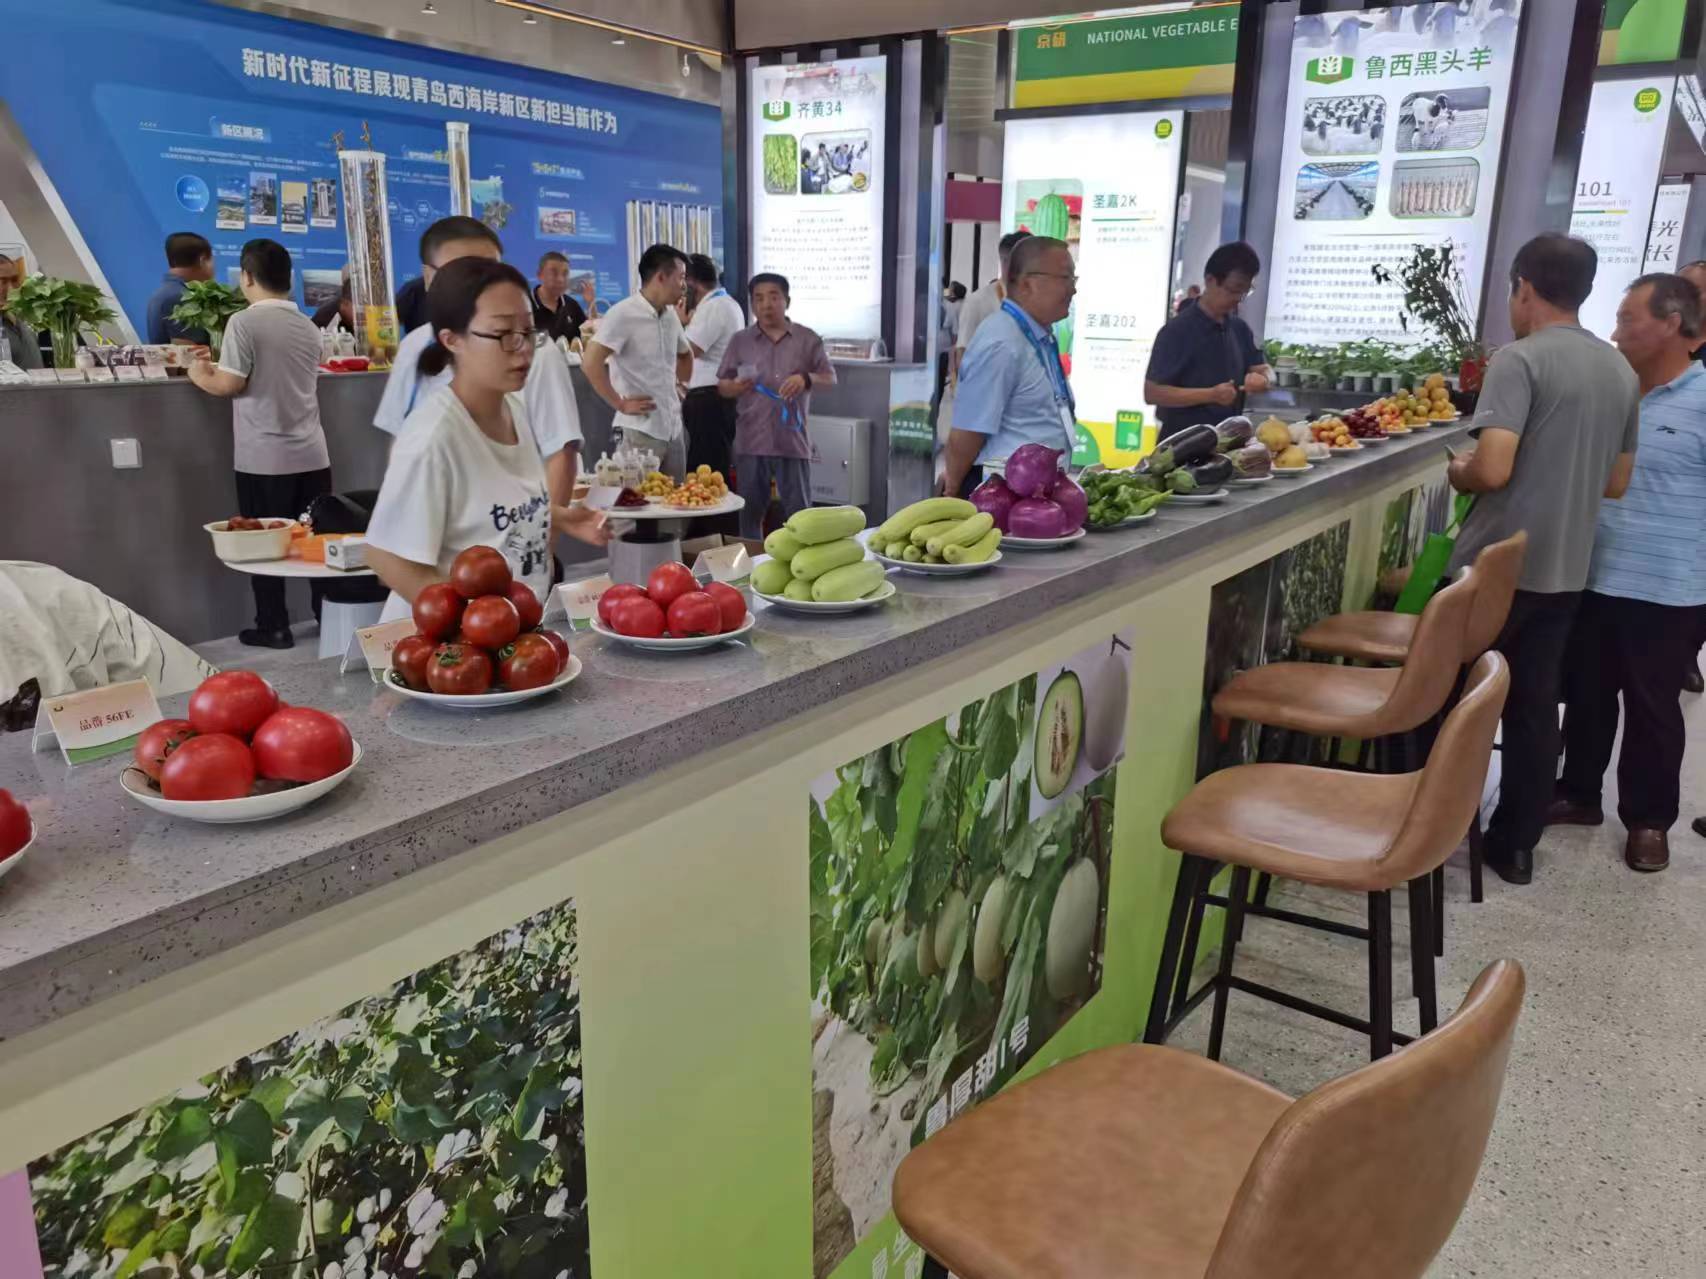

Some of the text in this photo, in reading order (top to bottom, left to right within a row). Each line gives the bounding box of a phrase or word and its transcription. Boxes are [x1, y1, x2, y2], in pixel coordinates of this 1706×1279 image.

[1087, 24, 1148, 45] NATIONAL
[1152, 18, 1225, 39] VEGETABLE
[1365, 45, 1492, 80] 鲁西黑头羊
[242, 46, 618, 136] 新时代新征程展现青岛西海岸新区新担当新作为
[798, 101, 842, 119] 齐黄34
[1577, 181, 1613, 197] 101
